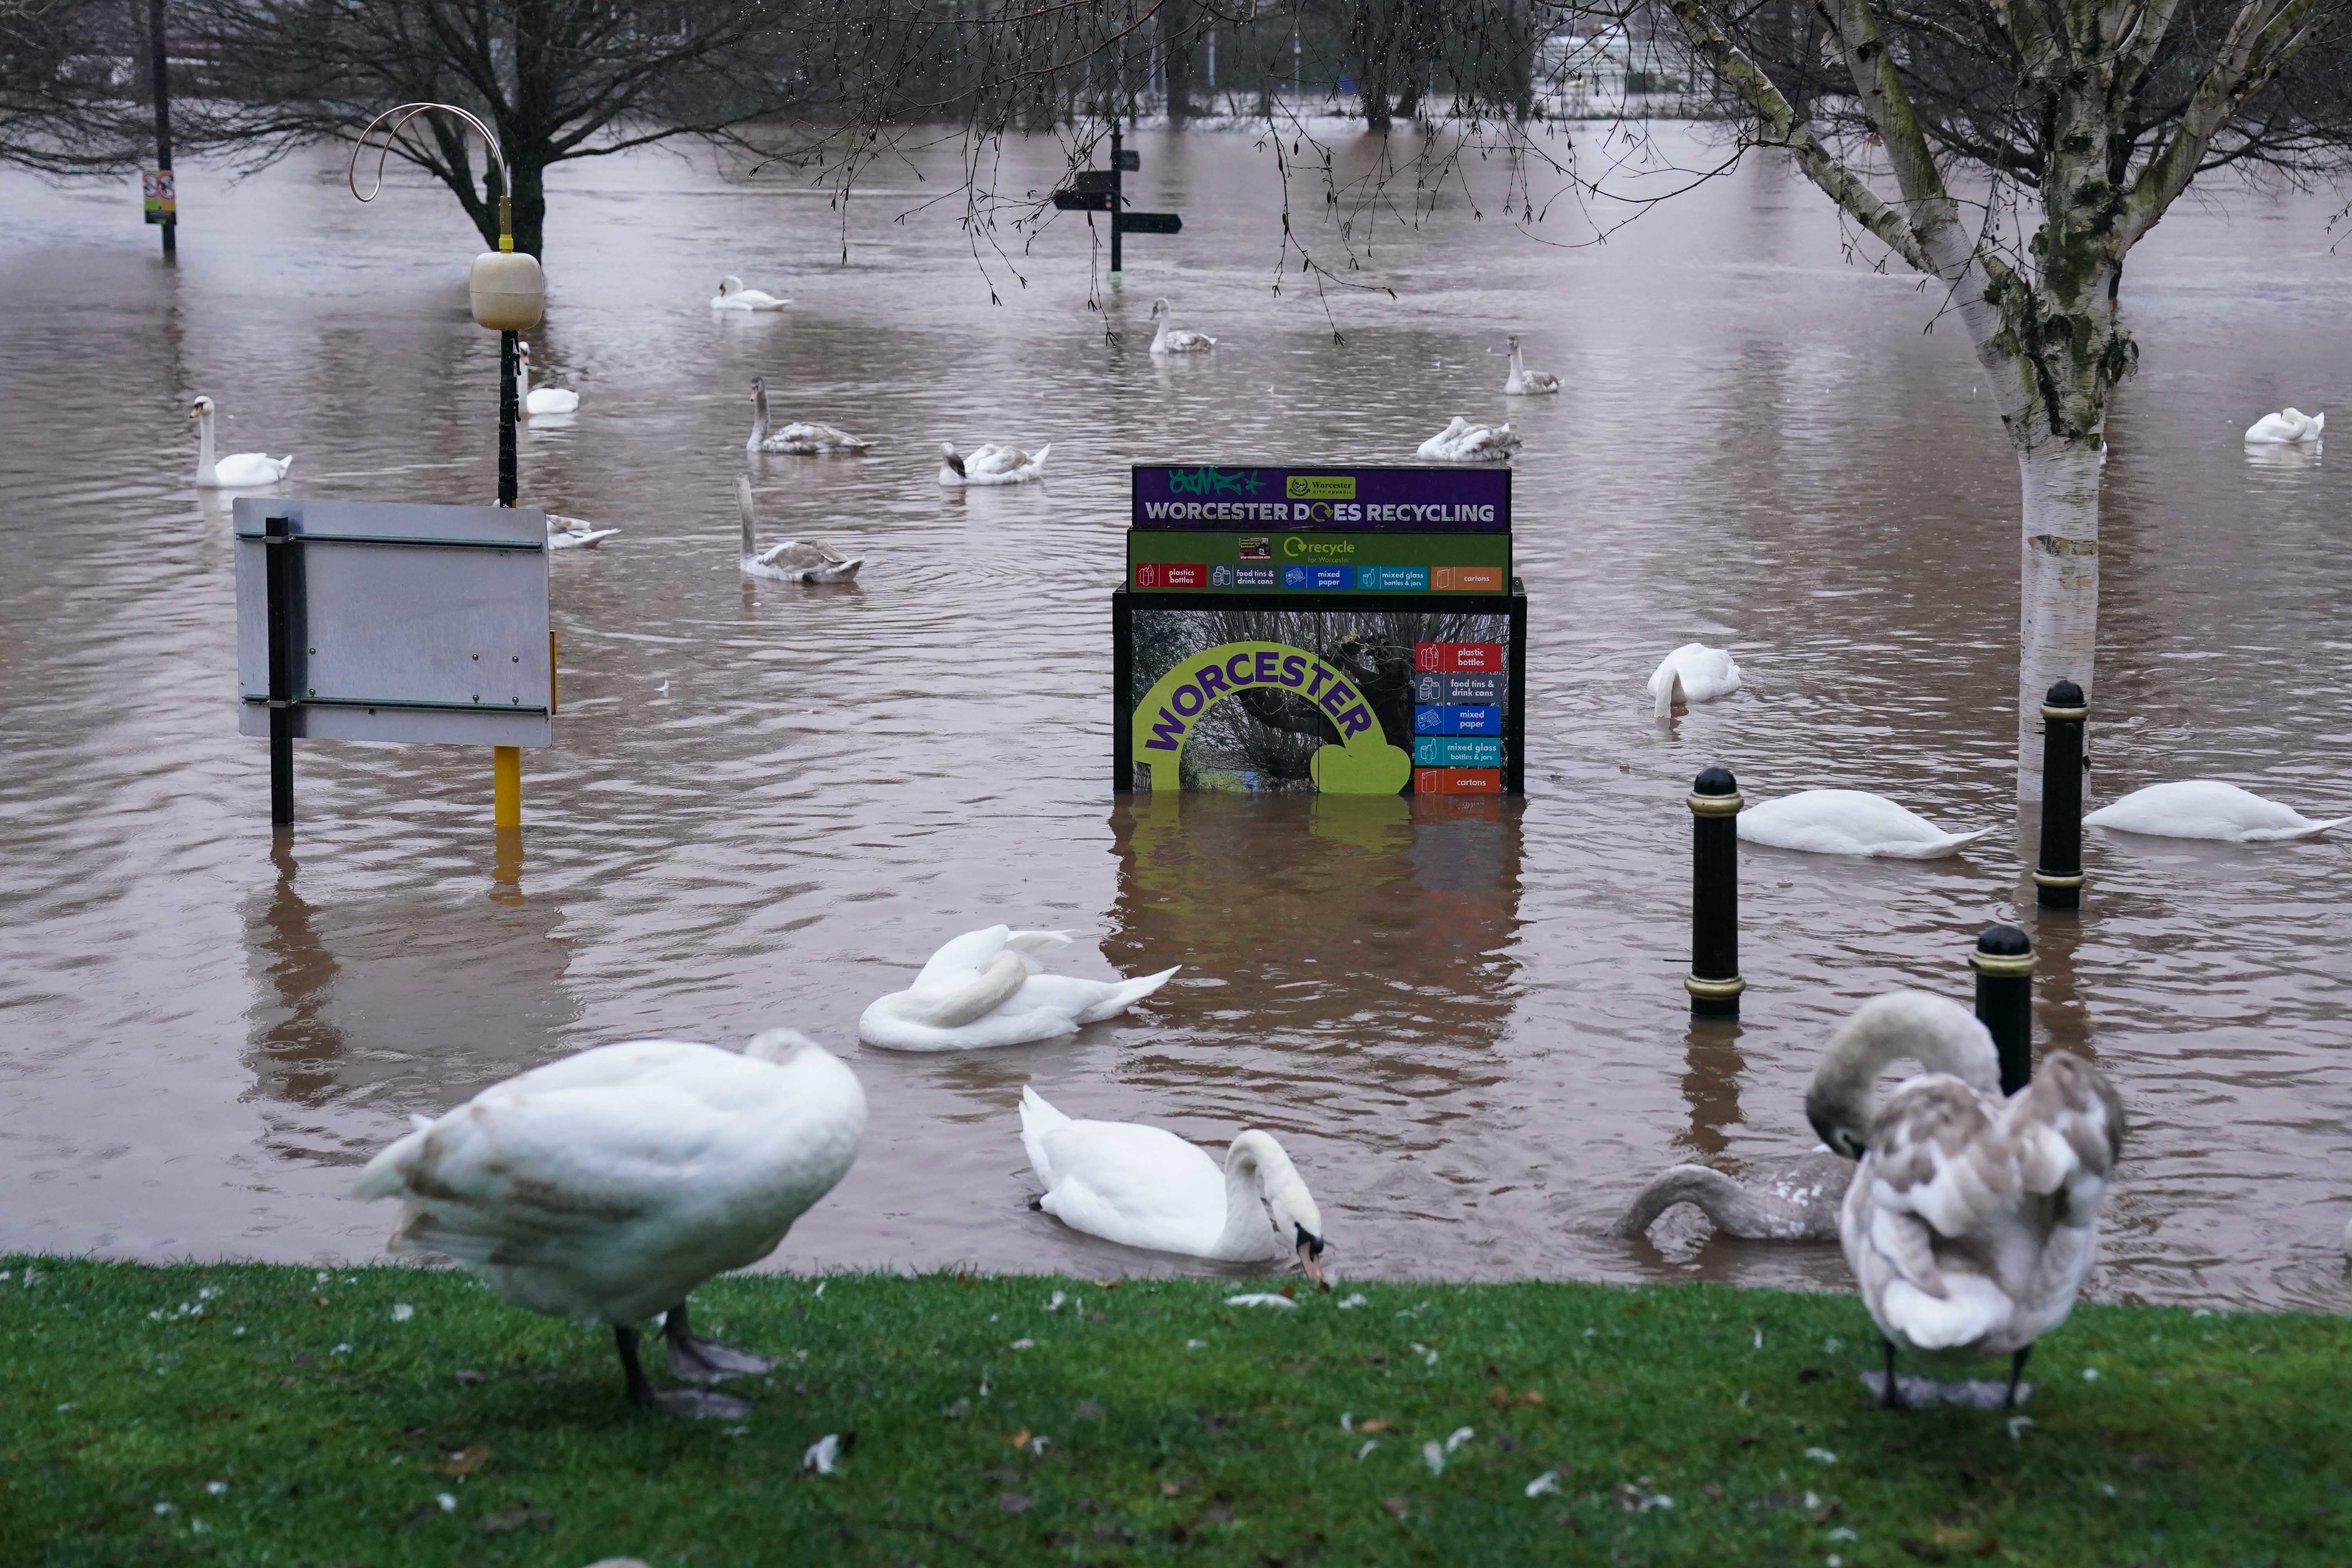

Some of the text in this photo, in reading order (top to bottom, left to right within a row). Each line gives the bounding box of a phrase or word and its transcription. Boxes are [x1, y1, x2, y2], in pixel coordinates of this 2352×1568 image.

[1145, 502, 1288, 520] WORCESTER
[1367, 504, 1494, 521] RECYCLING
[1308, 540, 1355, 555] recycle
[1169, 569, 1194, 577] plastics
[1458, 648, 1484, 657] plastic
[1451, 679, 1469, 687] food
[1452, 688, 1473, 696] drink
[1145, 652, 1372, 751] WORCESTER
[1475, 743, 1496, 753] glass
